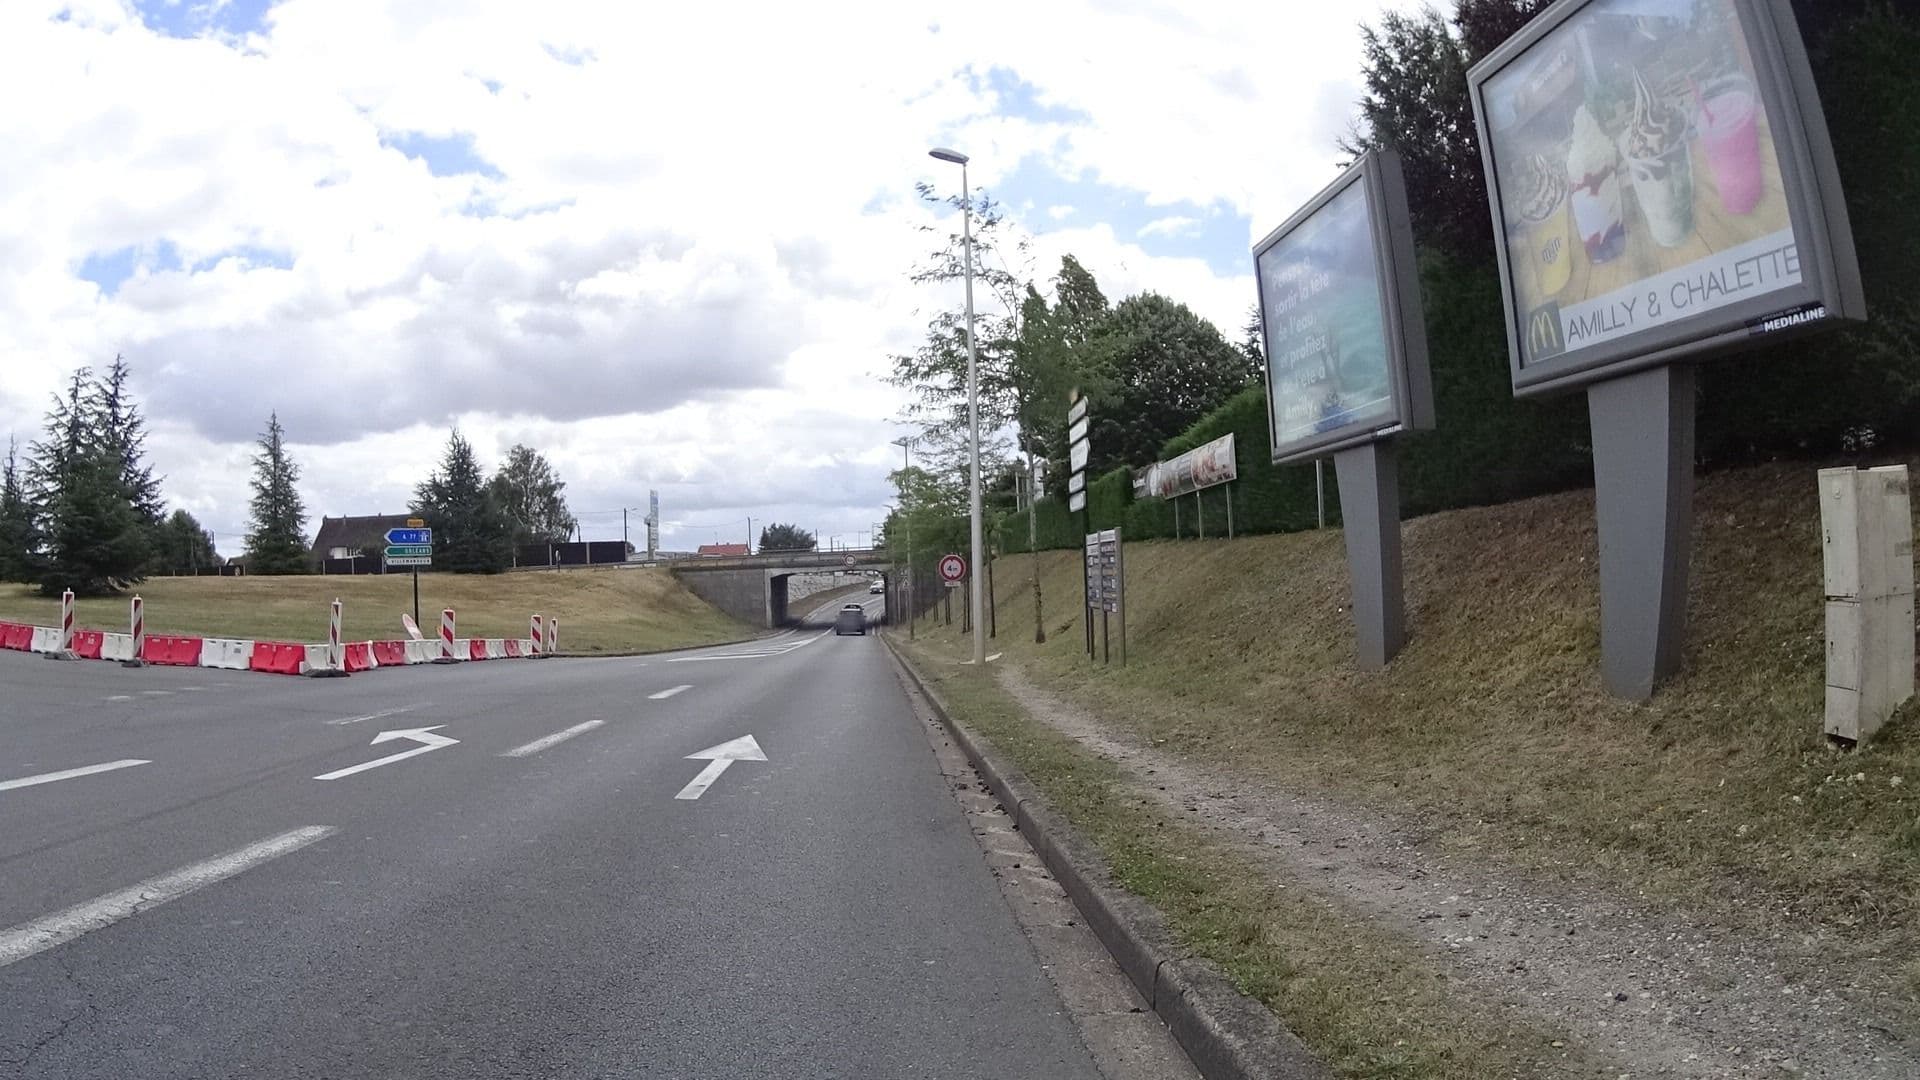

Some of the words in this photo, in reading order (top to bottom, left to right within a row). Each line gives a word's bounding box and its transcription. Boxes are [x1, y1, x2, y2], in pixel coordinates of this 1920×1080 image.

[1567, 296, 1637, 345] AMILLY
[1647, 291, 1662, 318] &
[1669, 242, 1801, 309] CHALETTE
[1763, 306, 1827, 333] MEDIALINE
